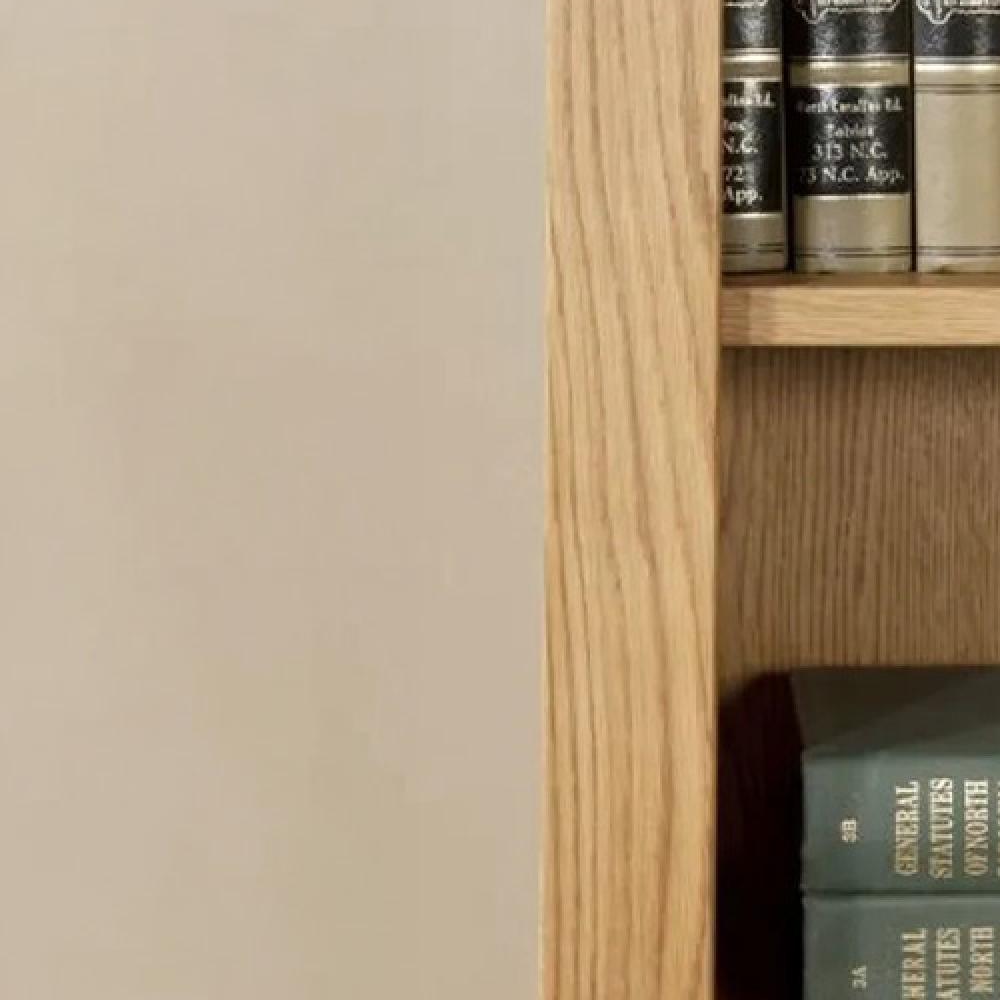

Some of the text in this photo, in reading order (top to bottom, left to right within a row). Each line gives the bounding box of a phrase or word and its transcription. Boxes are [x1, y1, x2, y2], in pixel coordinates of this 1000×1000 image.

[821, 165, 860, 183] N.C.
[864, 165, 905, 185] App.
[849, 140, 889, 160] N.C.
[895, 779, 920, 876] GENERAL
[929, 777, 953, 879] STATUTES
[964, 779, 989, 876] OF NORTH
[901, 927, 927, 1000] NERAL
[935, 927, 961, 1000] ATUTES
[970, 927, 995, 994] NORTH
